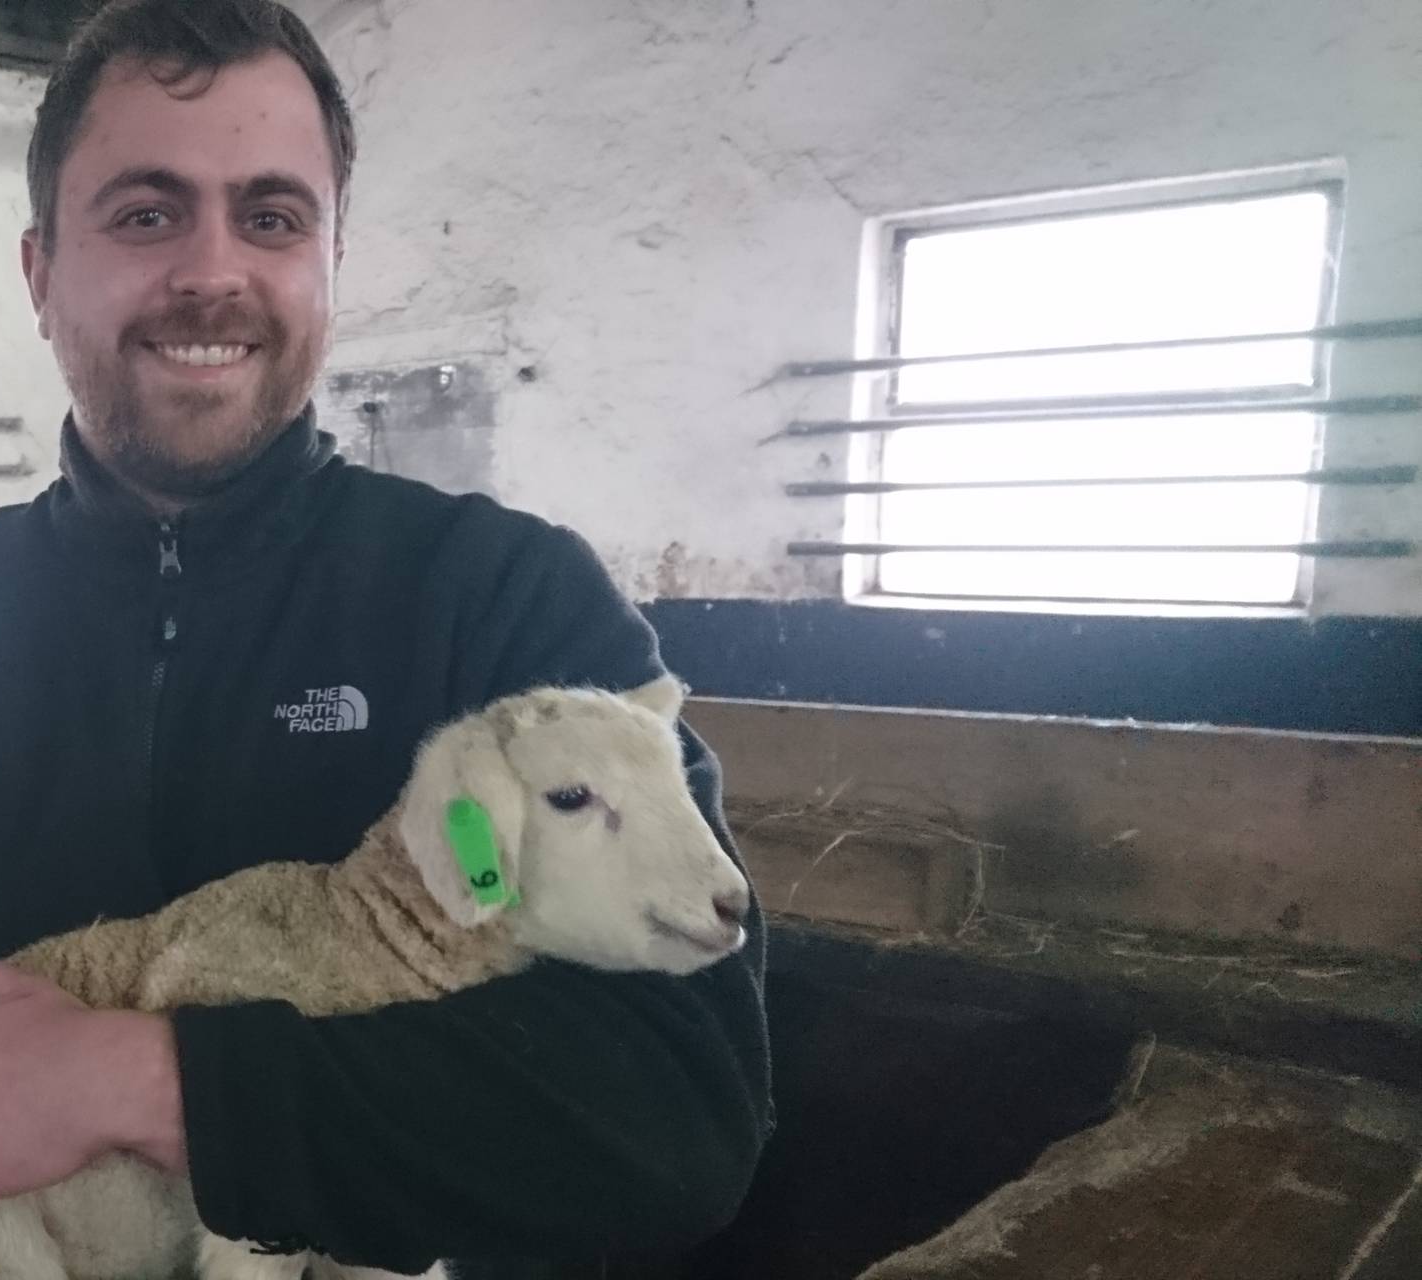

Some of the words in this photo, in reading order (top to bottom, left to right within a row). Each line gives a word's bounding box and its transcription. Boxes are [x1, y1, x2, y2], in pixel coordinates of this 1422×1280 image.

[305, 687, 339, 703] THE
[274, 702, 338, 719] NORTH
[289, 717, 337, 732] FACE
